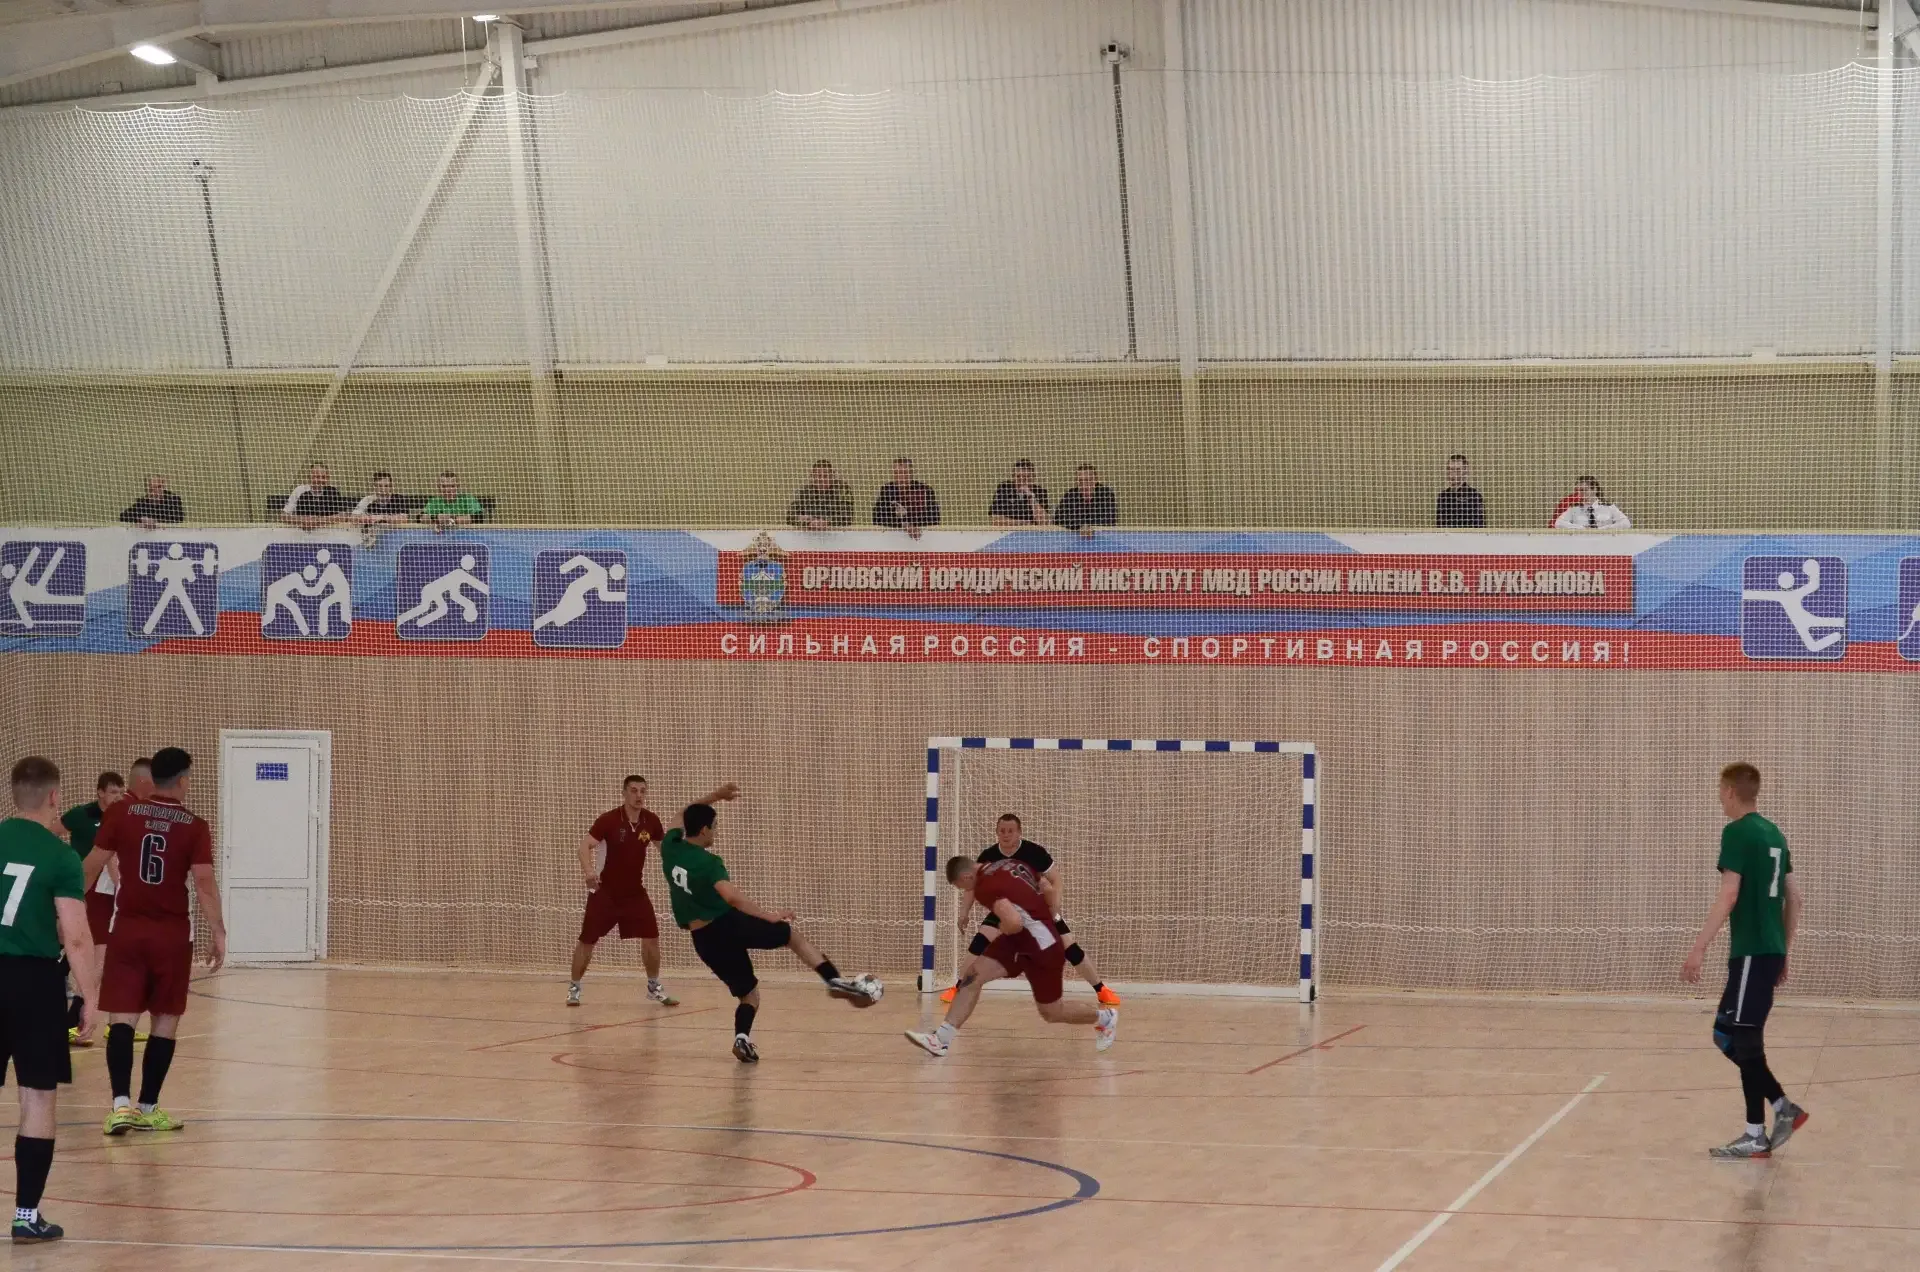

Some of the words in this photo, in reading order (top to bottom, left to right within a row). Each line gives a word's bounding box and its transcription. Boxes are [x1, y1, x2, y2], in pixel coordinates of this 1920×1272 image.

[802, 562, 922, 591] ОРЛОВСКИЙ
[929, 563, 1083, 594] ЮРИДИЧЕСКИЙ
[1090, 568, 1195, 592] ИНСТИТУТ
[1202, 568, 1250, 596] МВД
[1257, 569, 1341, 593] РОССИИ
[1348, 569, 1422, 593] ИМЕНИ
[1428, 570, 1470, 593] В.В.
[1477, 570, 1605, 595] ЛУКЬЯНОВА
[720, 634, 906, 656] СИЛЬНАЯ
[923, 635, 1085, 657] РОССИЯ
[1143, 637, 1422, 660] СПОРТИВНАЯ
[1442, 641, 1630, 662] РОССИЯ!
[139, 833, 166, 885] 6
[671, 864, 693, 896] 9
[1769, 847, 1782, 898] 7
[1, 862, 36, 927] 7
